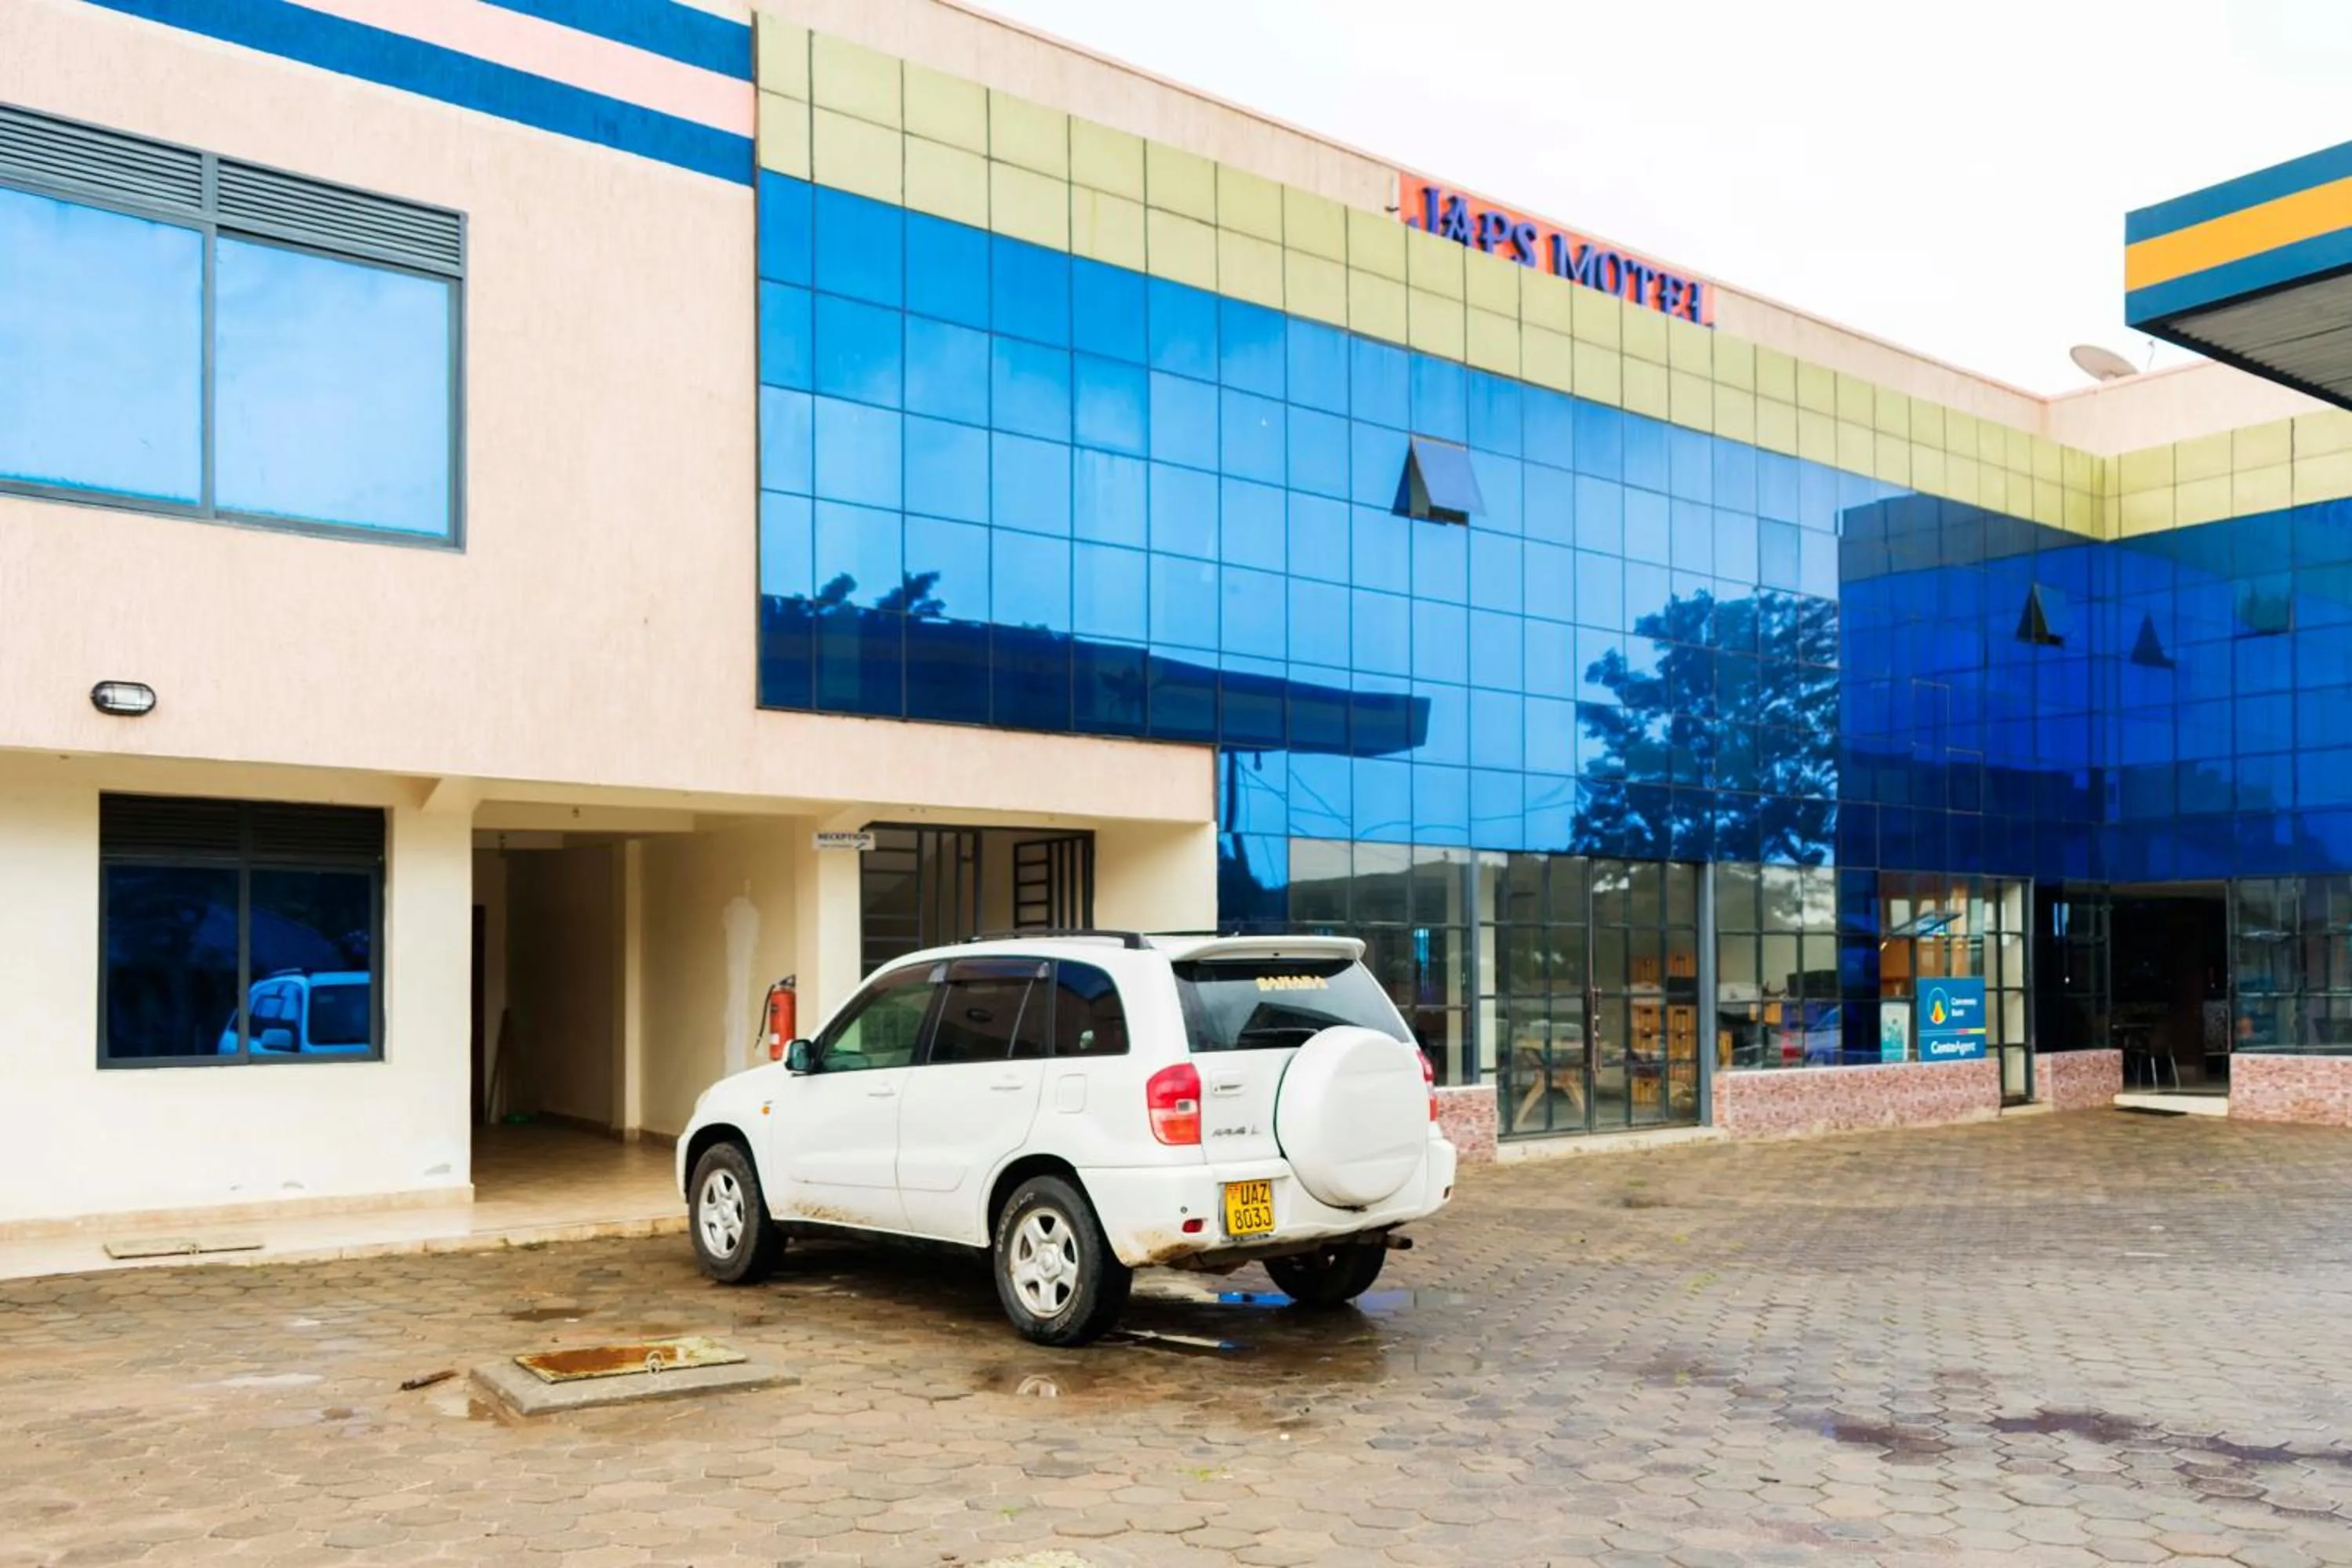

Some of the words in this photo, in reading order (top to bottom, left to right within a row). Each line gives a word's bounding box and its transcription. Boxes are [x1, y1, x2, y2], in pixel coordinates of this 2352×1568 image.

[1406, 187, 1537, 268] JAPS
[1548, 232, 1715, 329] MOTEL
[1241, 1183, 1268, 1204] UAZ
[1234, 1206, 1272, 1230] 803J
